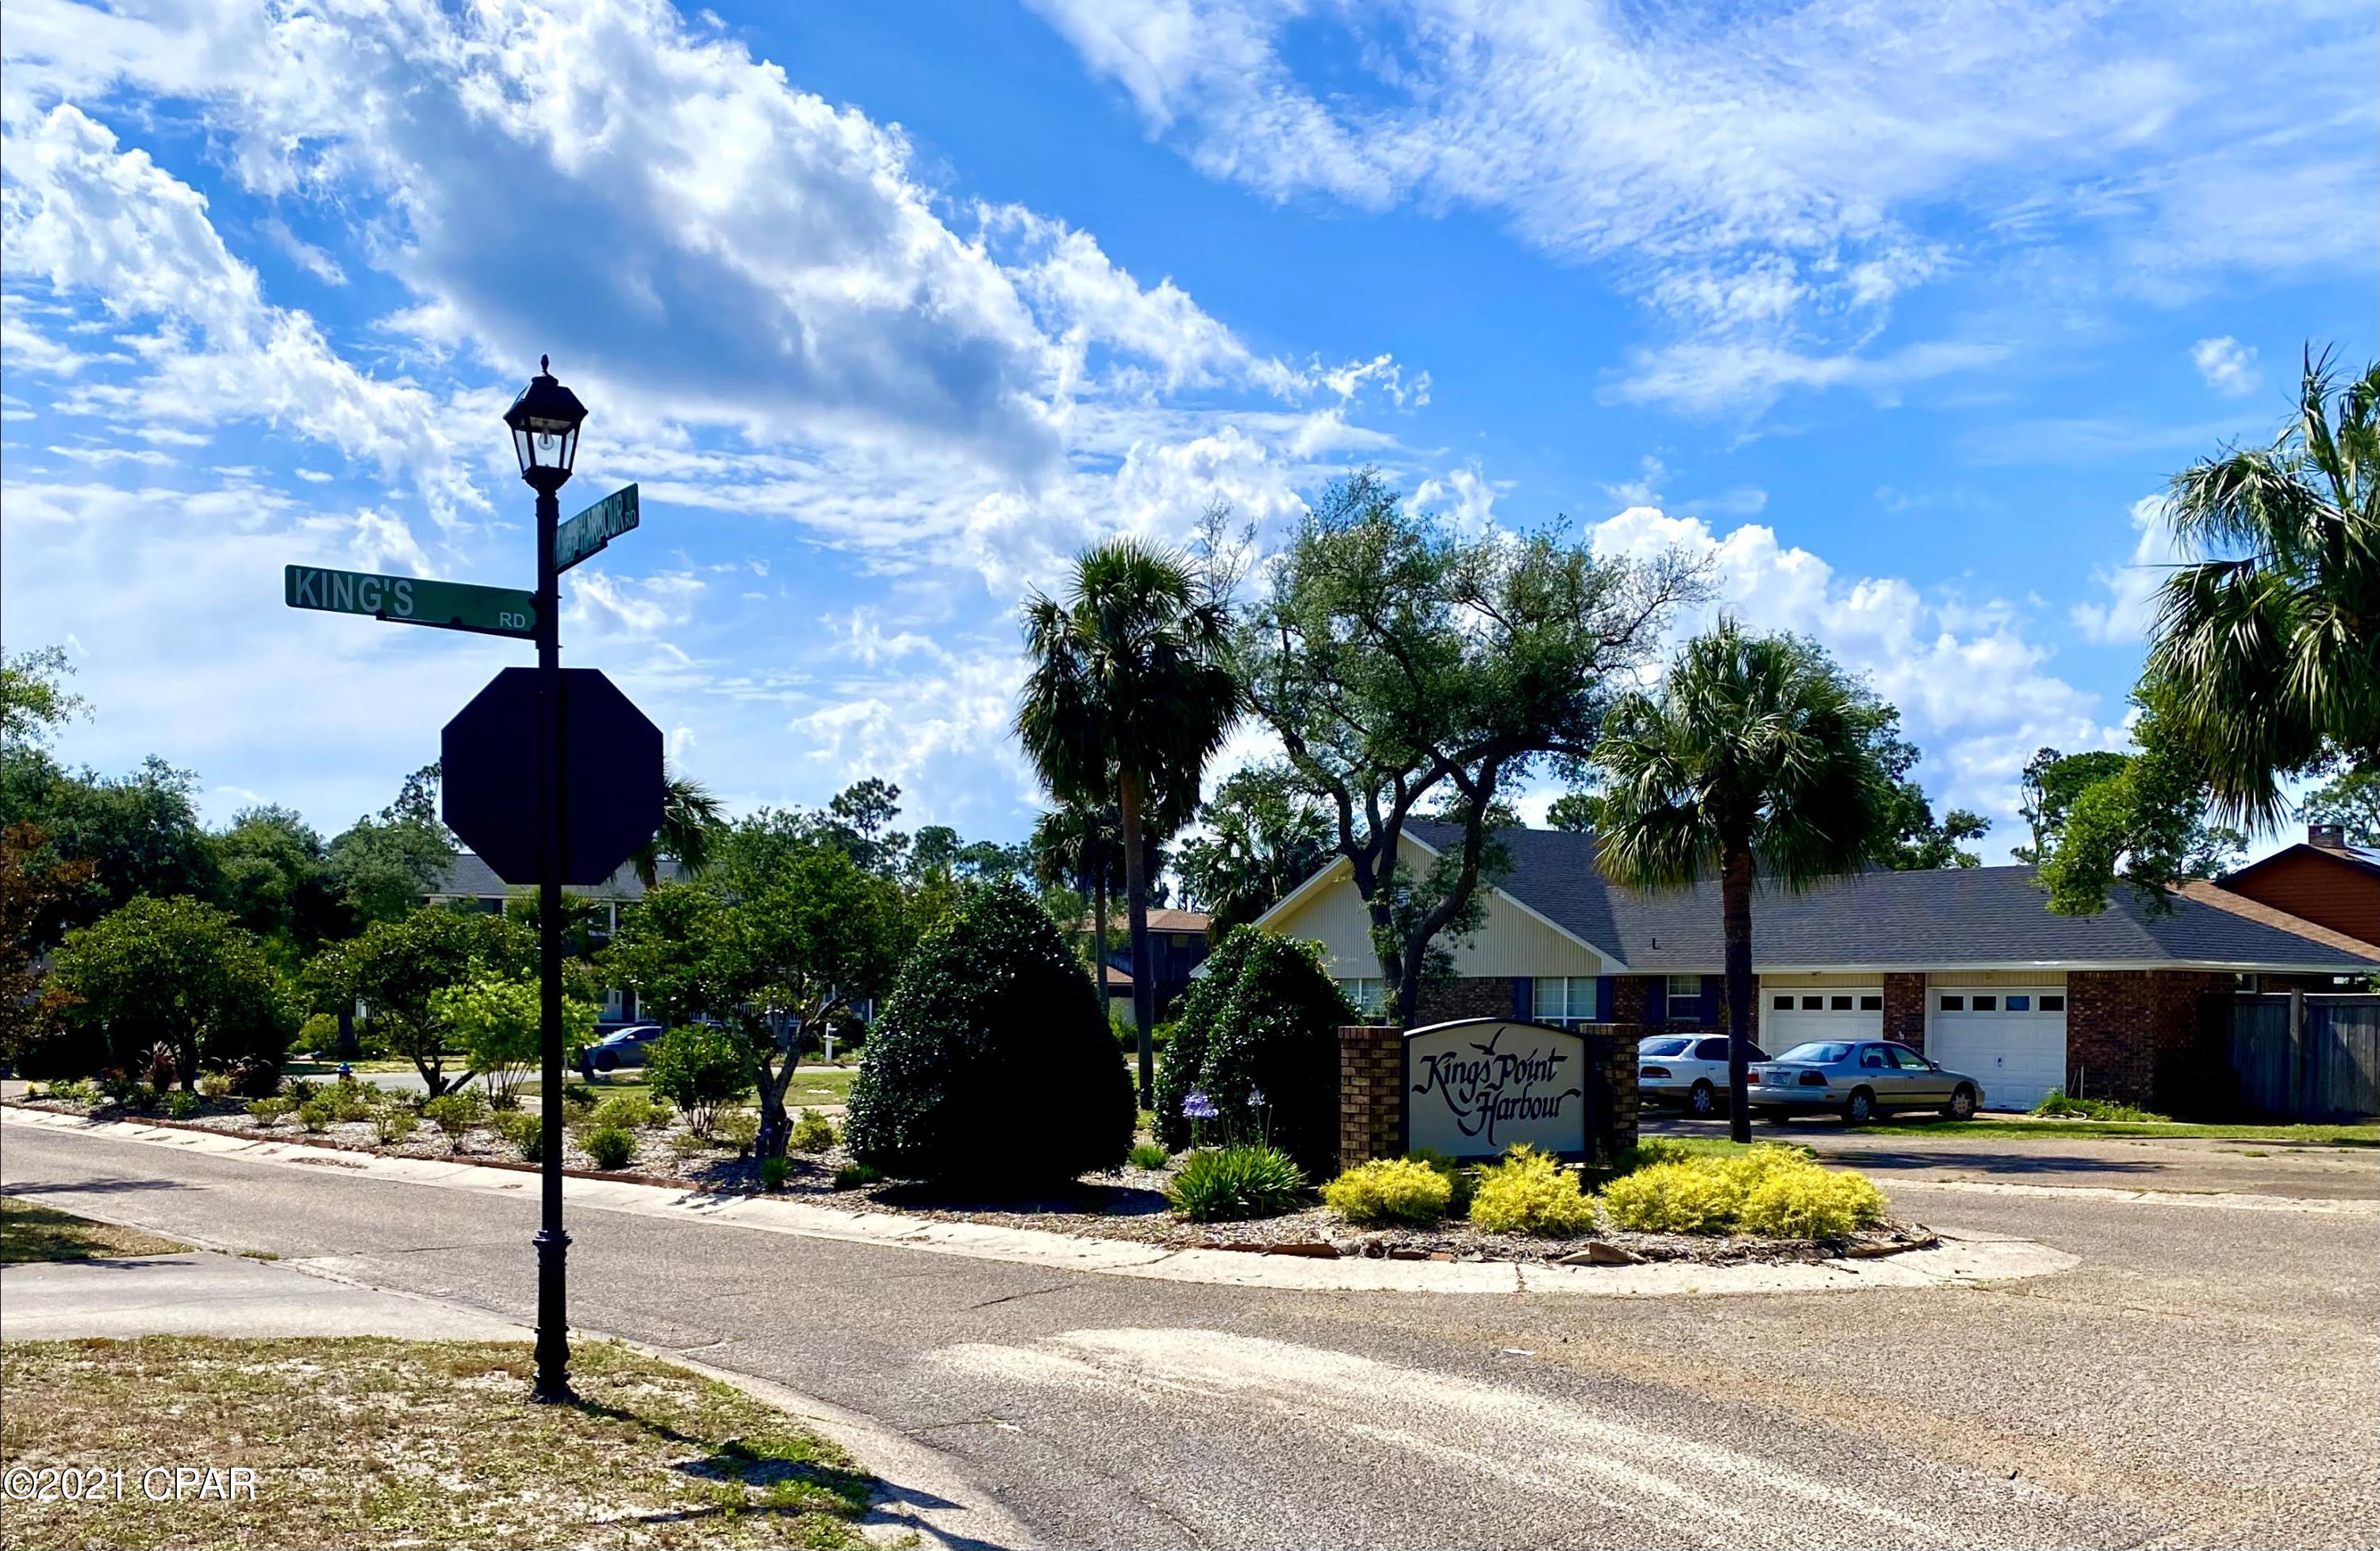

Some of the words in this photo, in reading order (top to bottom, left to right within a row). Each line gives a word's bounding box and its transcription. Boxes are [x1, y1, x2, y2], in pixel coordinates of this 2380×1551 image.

[625, 509, 636, 528] RD
[294, 569, 413, 616] KING'S
[500, 612, 526, 629] RD
[1484, 1047, 1568, 1091] Point
[1457, 1081, 1582, 1147] Harbour
